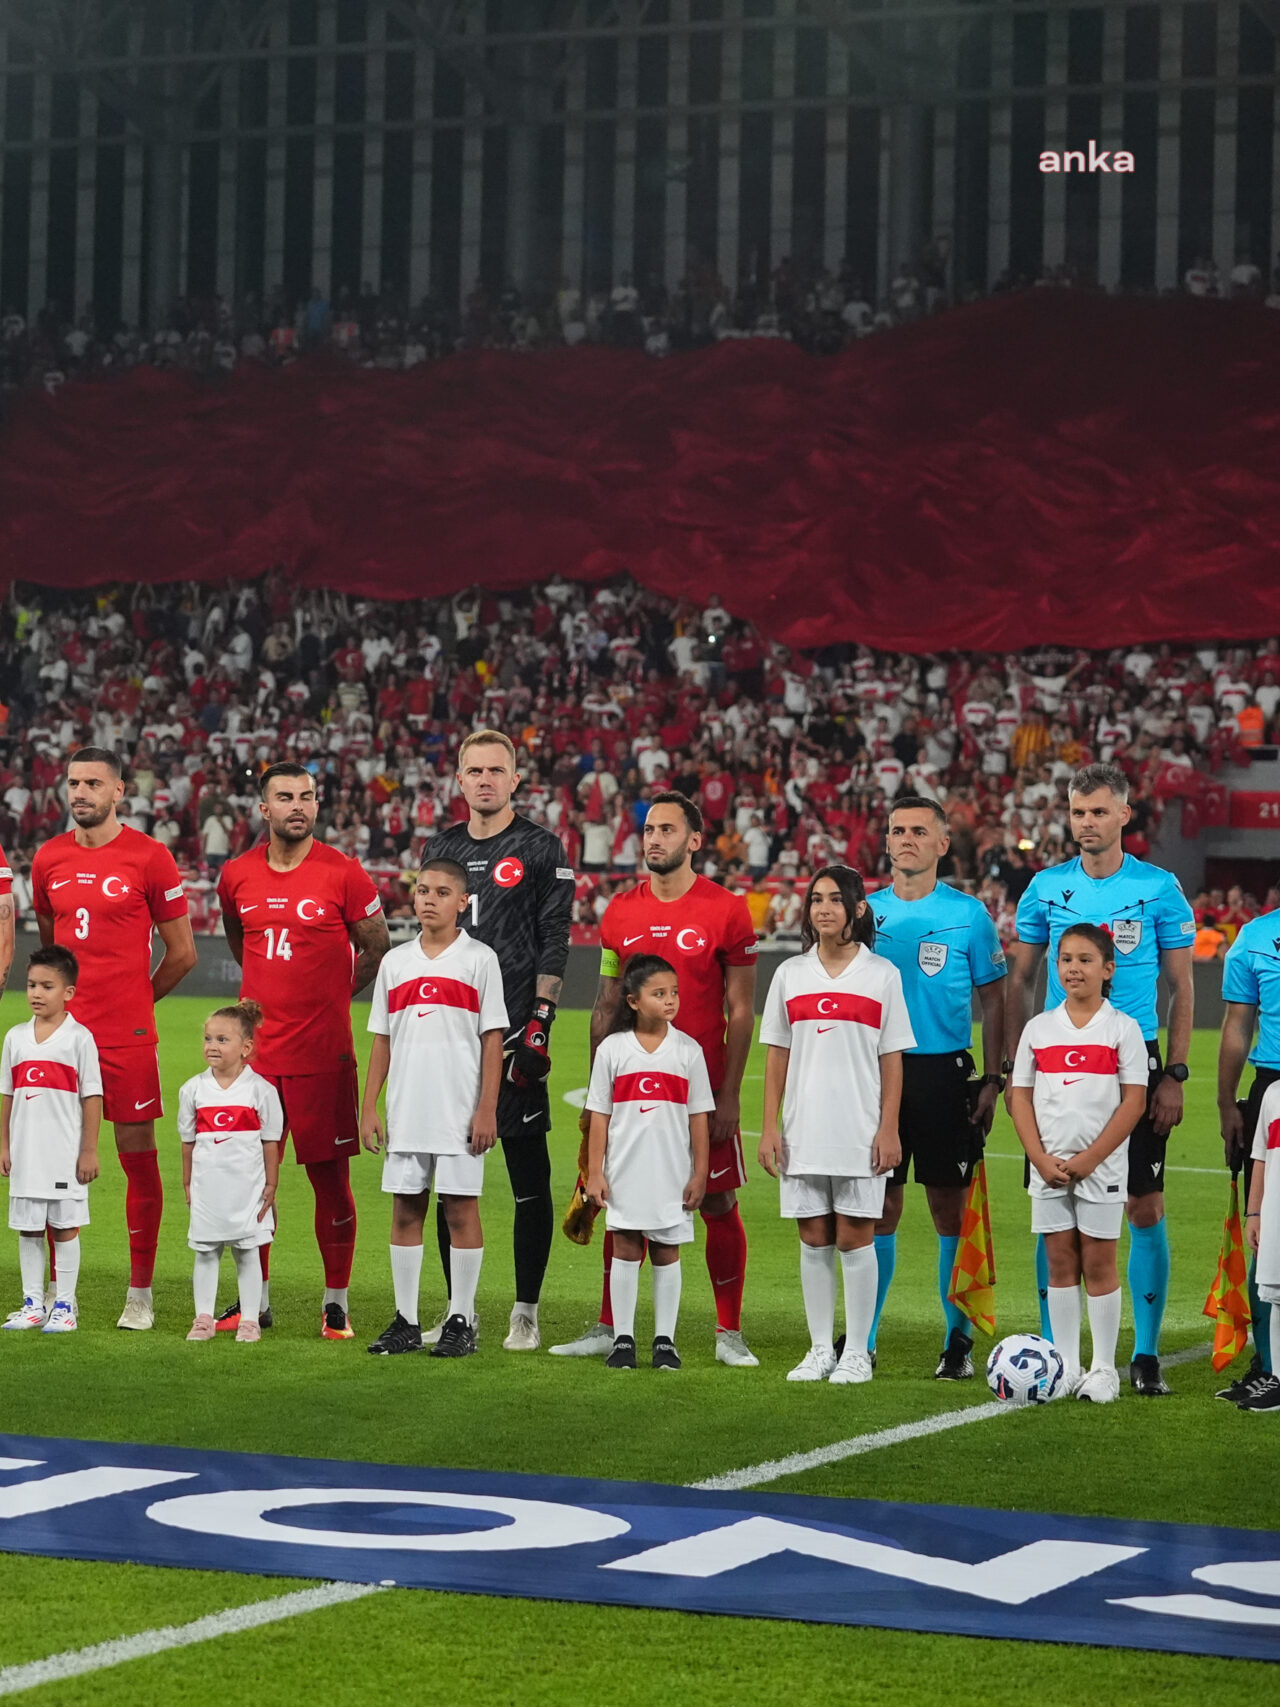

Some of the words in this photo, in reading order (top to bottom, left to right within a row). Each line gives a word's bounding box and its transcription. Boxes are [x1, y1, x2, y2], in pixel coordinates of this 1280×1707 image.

[75, 907, 90, 940] 3
[468, 894, 478, 927] 1
[264, 927, 293, 961] 14
